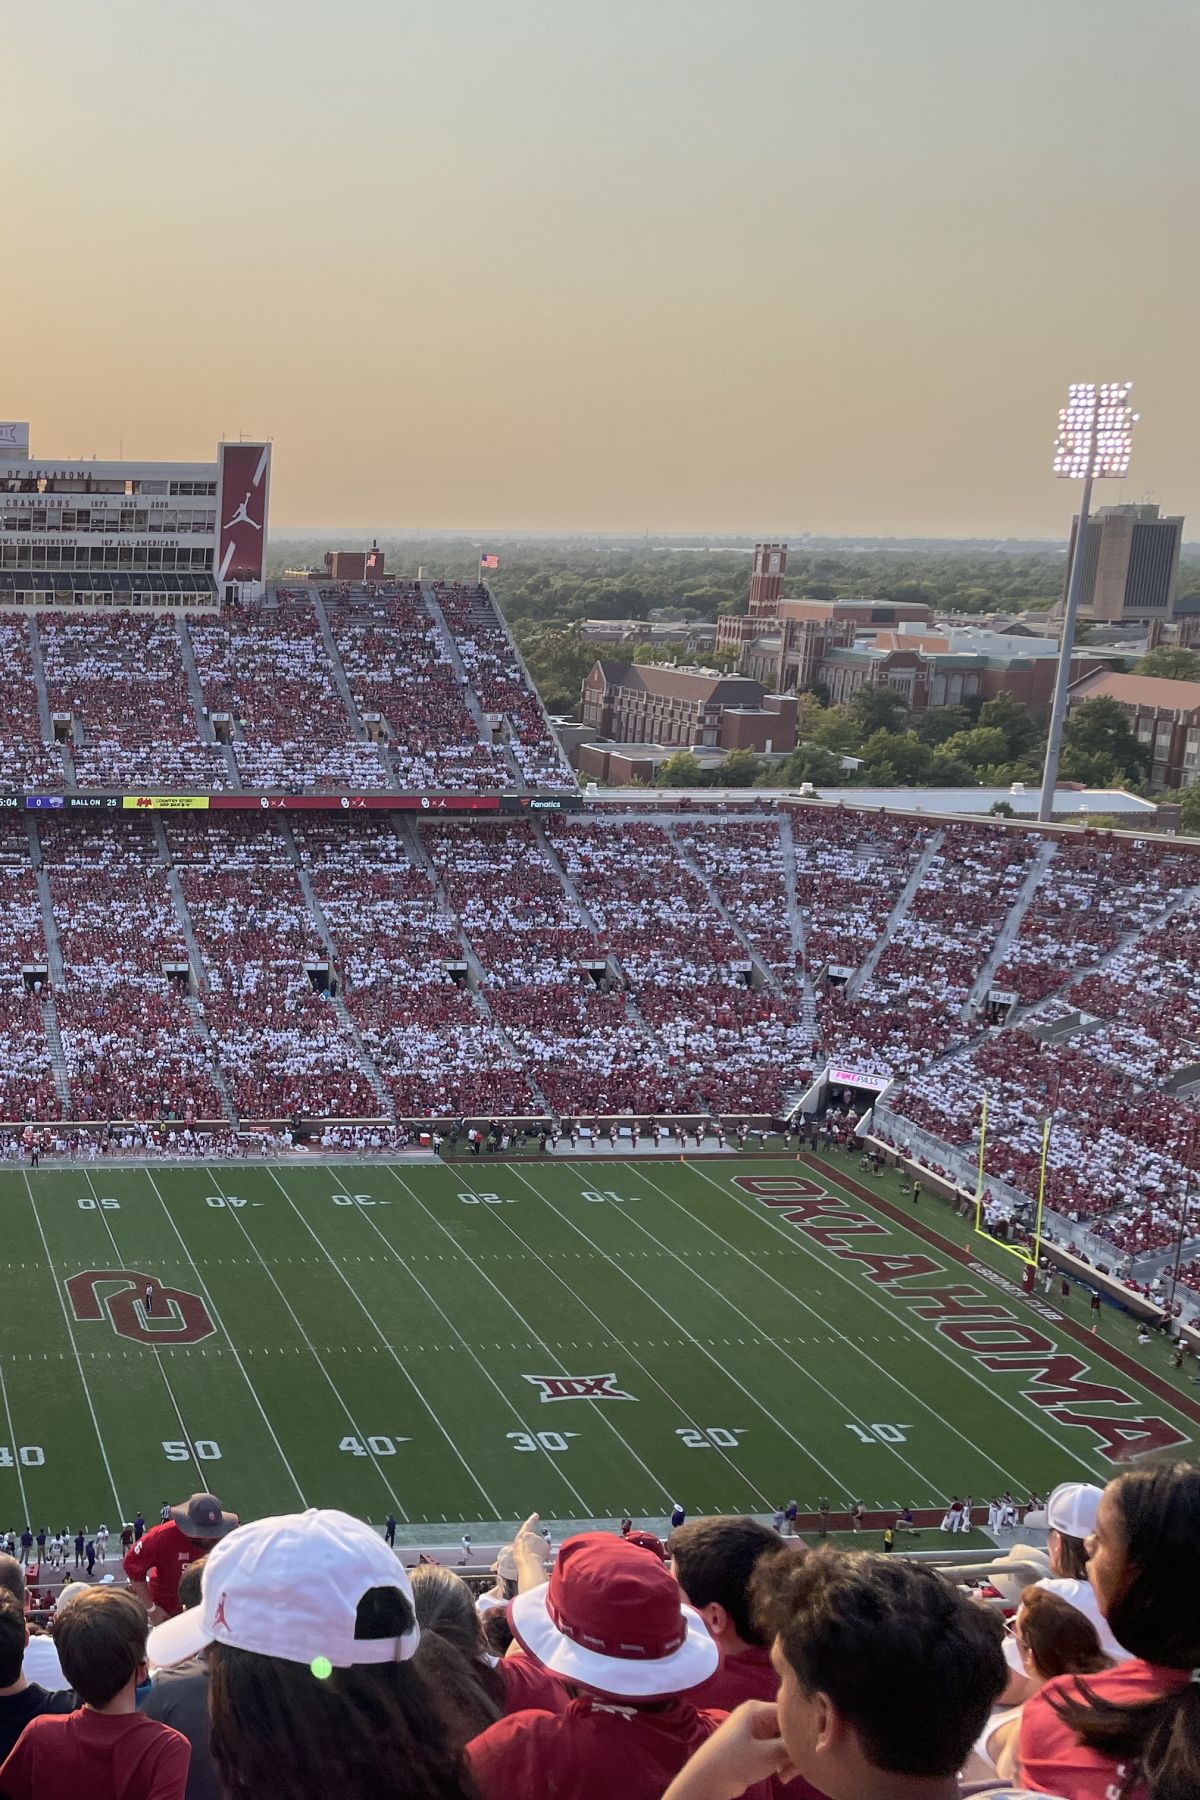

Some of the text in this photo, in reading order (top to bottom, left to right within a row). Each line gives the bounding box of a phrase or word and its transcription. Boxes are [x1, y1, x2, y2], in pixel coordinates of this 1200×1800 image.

[7, 470, 21, 479] OF
[28, 471, 93, 480] OKLAHOMA
[6, 500, 70, 508] CHAMPIONS
[530, 799, 561, 808] Fanatics
[77, 1198, 121, 1209] 50
[205, 1196, 248, 1207] 40
[331, 1194, 375, 1206] 30
[456, 1193, 503, 1204] 20
[580, 1191, 624, 1202] 10
[975, 1268, 1029, 1297] SOONER
[1024, 1299, 1063, 1320] CLUB
[64, 1269, 217, 1345] OU
[730, 1175, 1194, 1466] OKLAHOMA
[505, 1431, 570, 1451] 30
[675, 1427, 739, 1448] 20
[845, 1423, 908, 1443] 10
[161, 1440, 222, 1461] 50
[339, 1436, 397, 1456] 40
